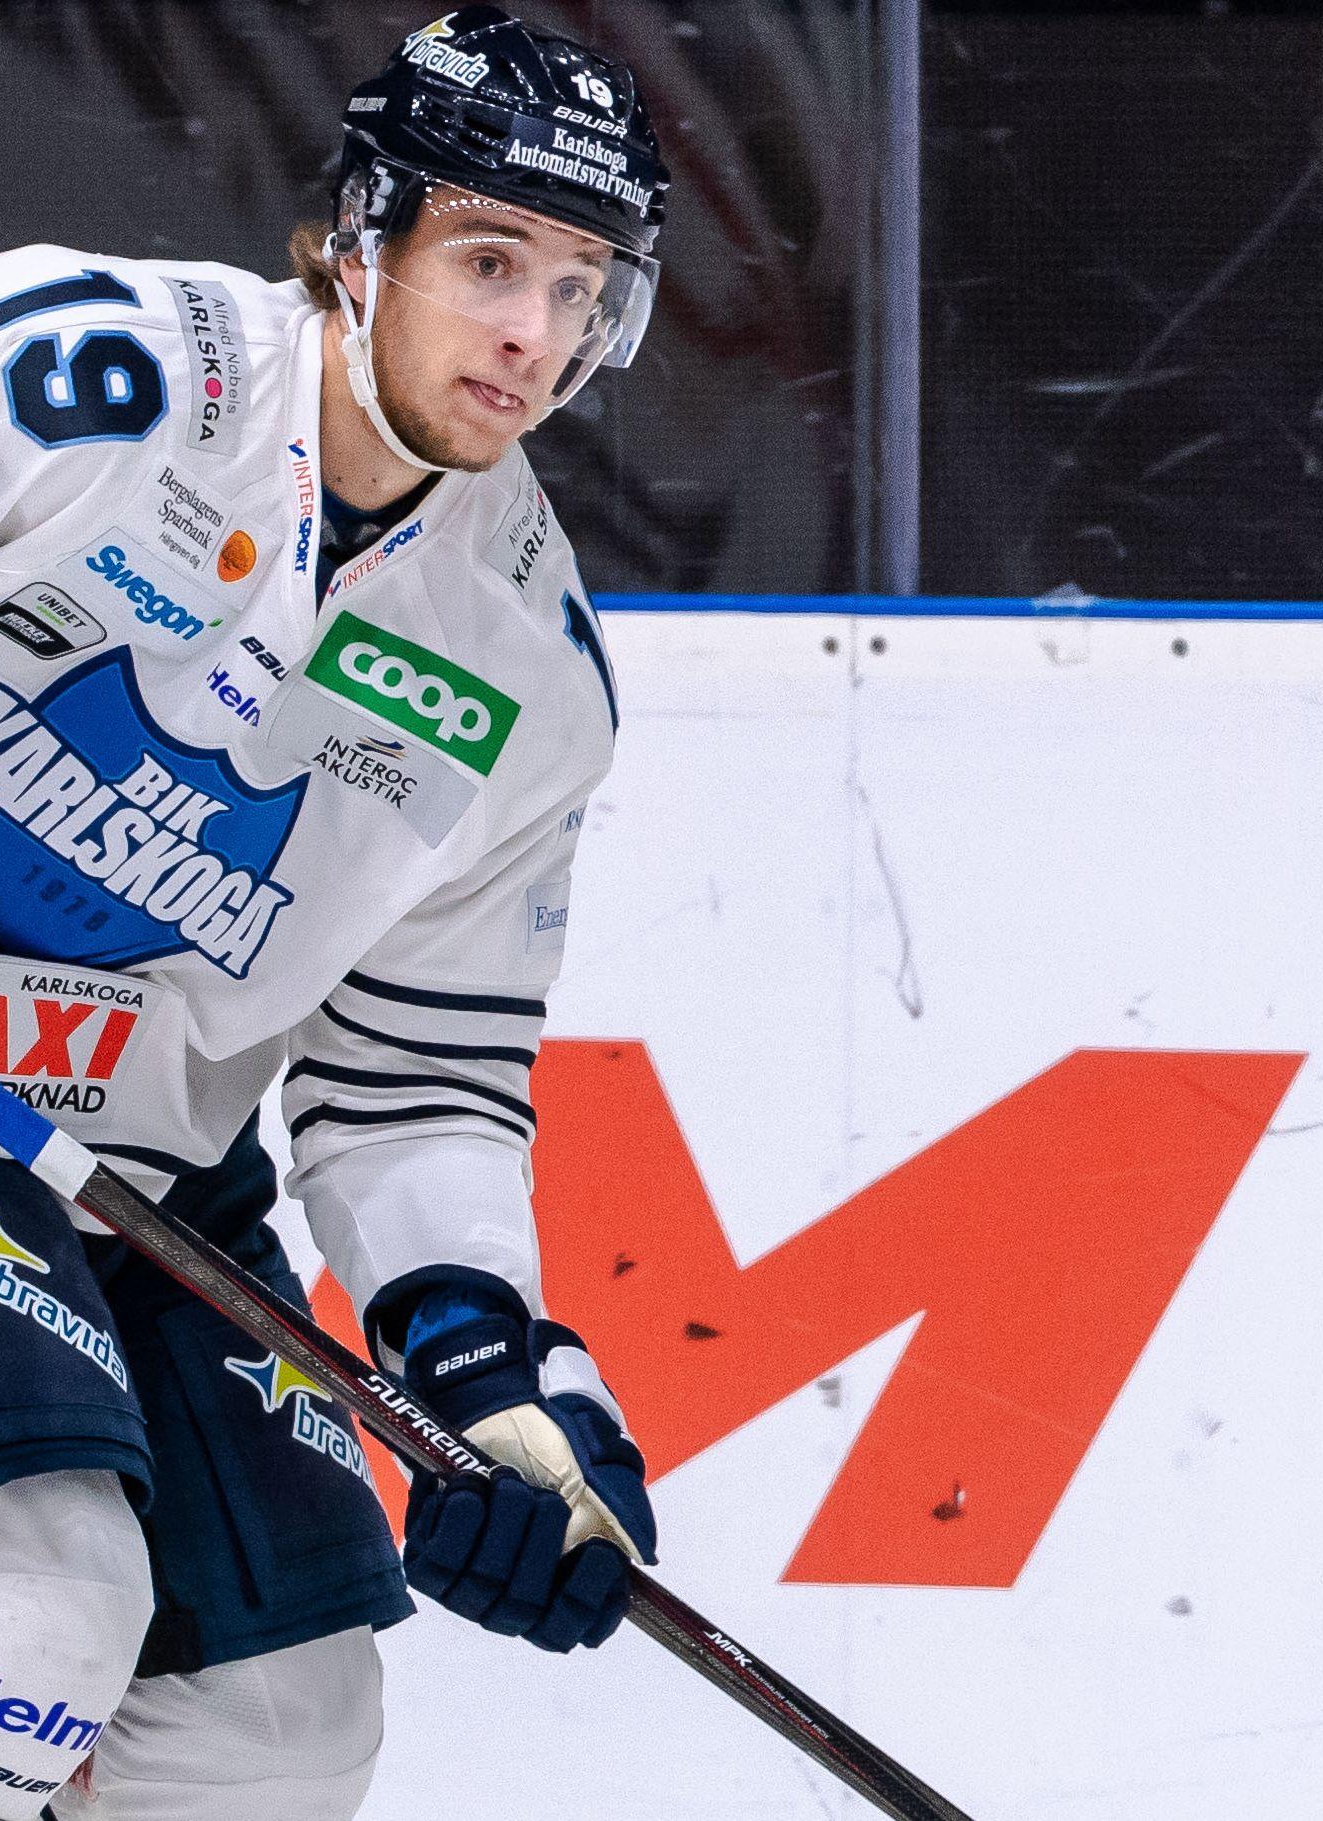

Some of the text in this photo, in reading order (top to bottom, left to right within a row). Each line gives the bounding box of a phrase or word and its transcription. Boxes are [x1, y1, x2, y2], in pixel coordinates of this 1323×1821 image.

[412, 36, 489, 88] bravida
[570, 72, 613, 108] 19
[551, 127, 627, 174] Karlskoga
[552, 105, 628, 139] BAUER
[505, 138, 653, 218] Automatsvarvning
[210, 297, 242, 414] Alfred Nobels
[157, 466, 224, 528] Bergslagens
[158, 499, 213, 550] Sparbank
[293, 460, 314, 575] INTERSPORT
[343, 518, 424, 588] INTERSPORT
[37, 593, 87, 628] UNIBET
[86, 545, 194, 641] Swegon
[338, 642, 491, 742] coop
[312, 751, 407, 810] AKUSTIK
[323, 735, 418, 794] INTEROC
[113, 753, 230, 843] BIK
[21, 974, 143, 1008] KARLSKOGA
[435, 1341, 506, 1377] BAUER
[703, 1631, 752, 1667] MPK
